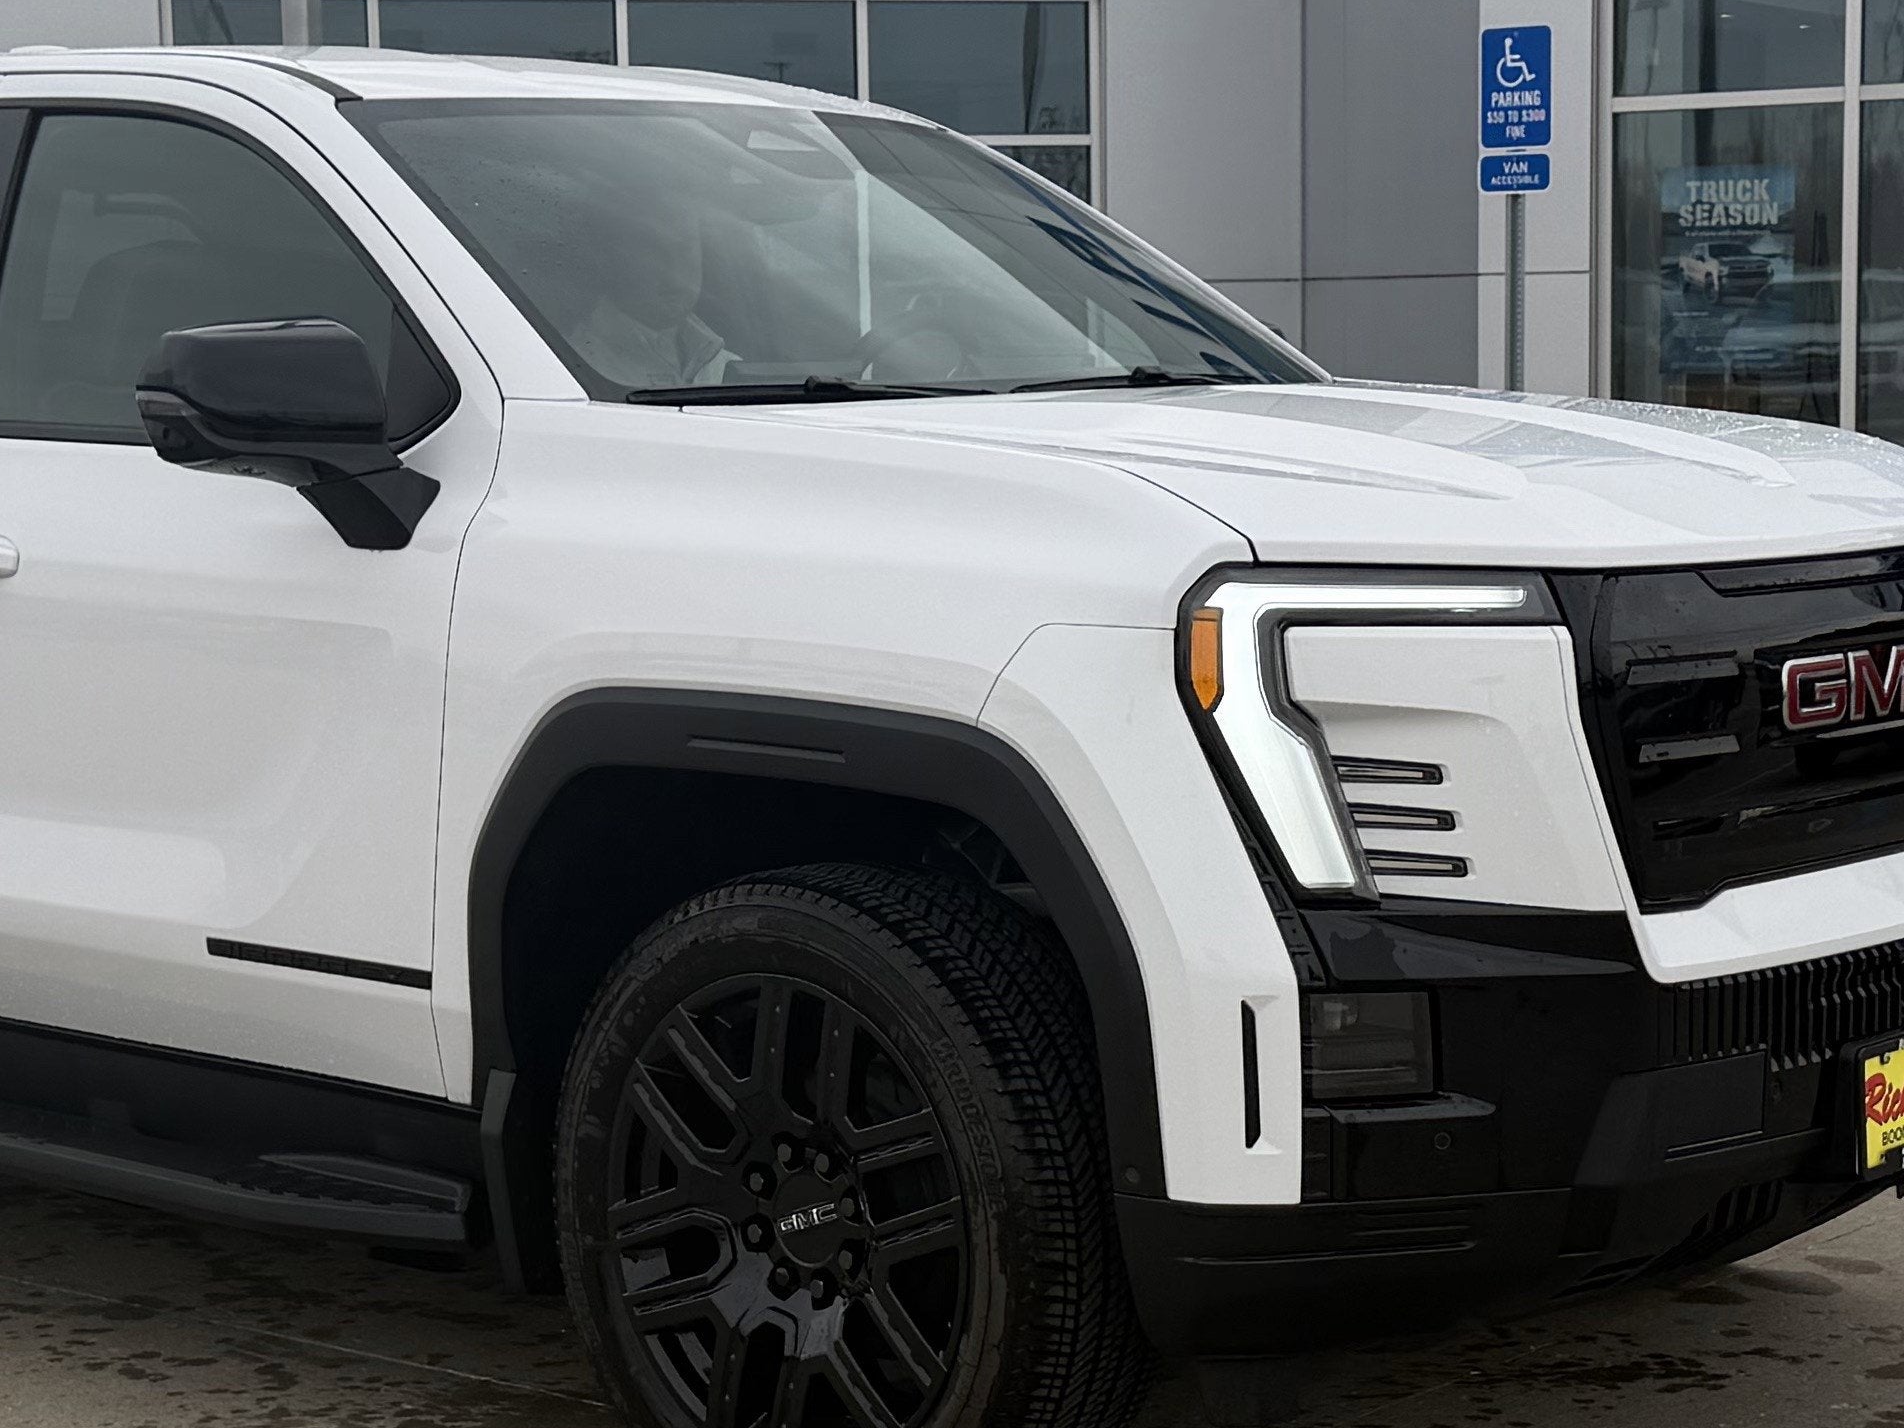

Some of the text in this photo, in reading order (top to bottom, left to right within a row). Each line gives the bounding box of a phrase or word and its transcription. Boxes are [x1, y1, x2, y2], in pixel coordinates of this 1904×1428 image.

[1491, 90, 1542, 107] PARKING
[1508, 110, 1519, 123] TO
[1506, 125, 1526, 138] FINE
[1503, 161, 1529, 174] VAN
[1491, 174, 1539, 186] ACCESSIBLE
[1686, 178, 1770, 203] TRUCK
[1678, 202, 1779, 226] SEASON
[779, 1202, 837, 1232] GMC
